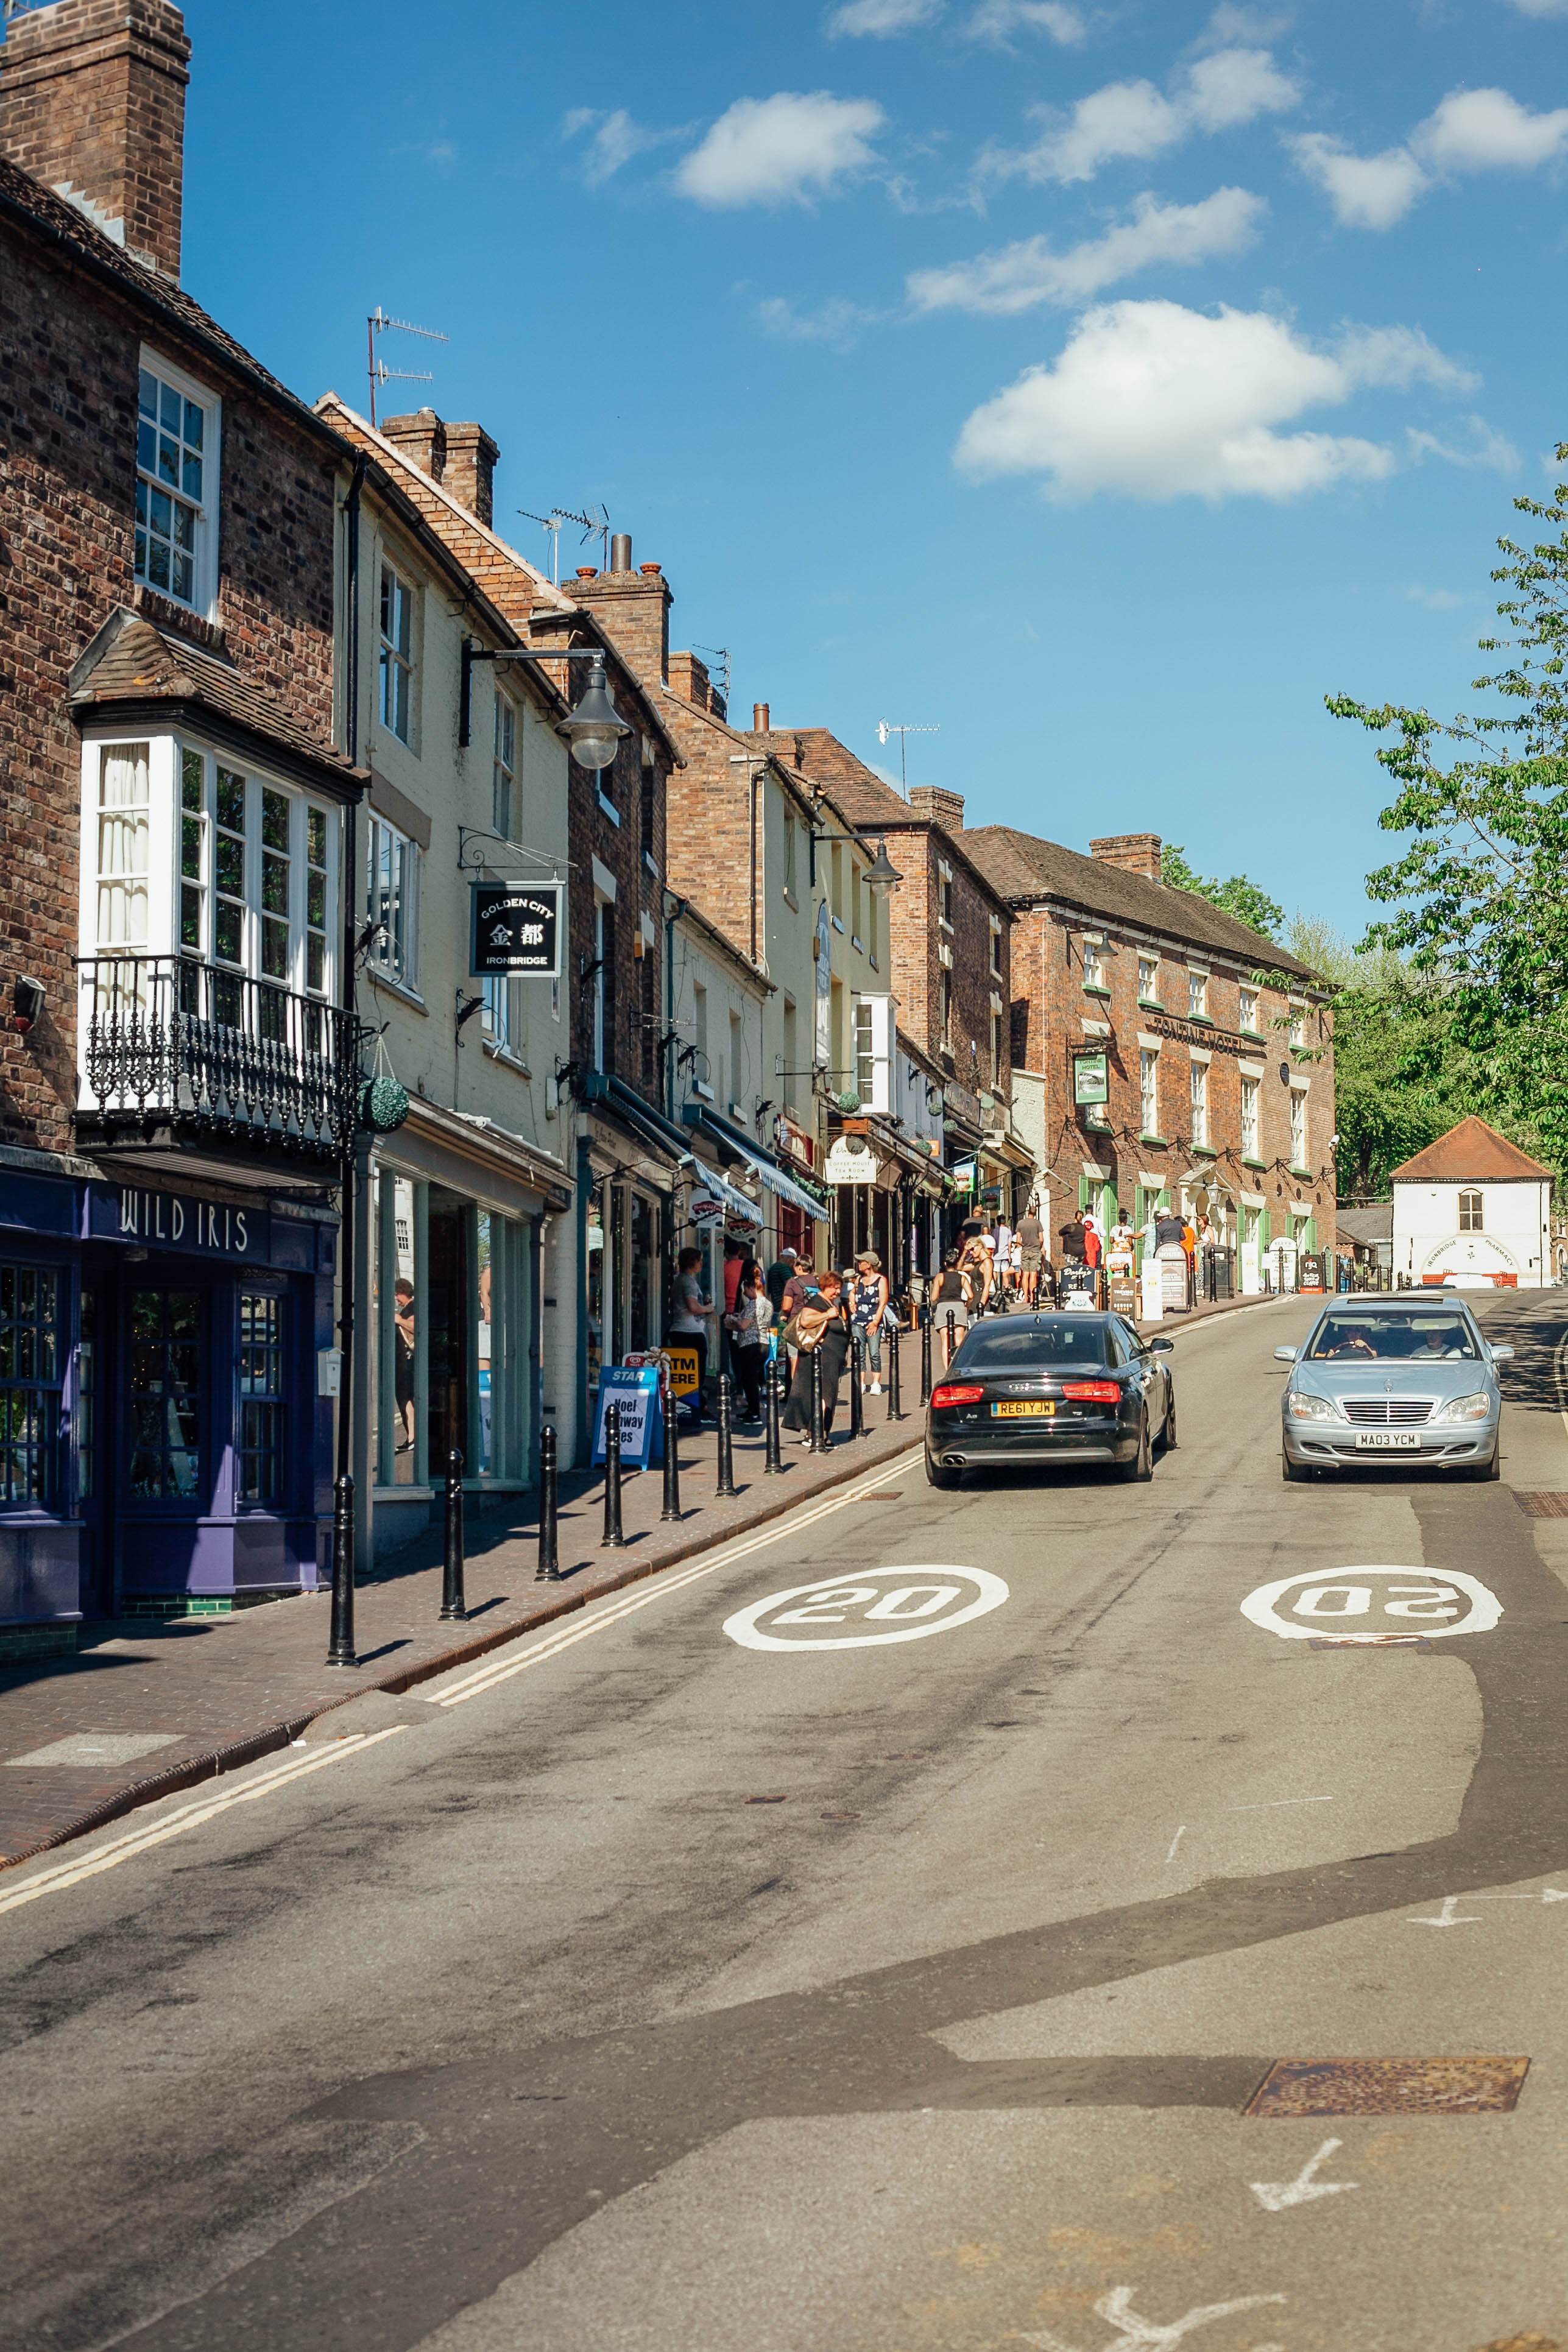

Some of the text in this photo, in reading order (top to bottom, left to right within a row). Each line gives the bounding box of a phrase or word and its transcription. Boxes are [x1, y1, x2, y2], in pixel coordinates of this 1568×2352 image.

[481, 899, 554, 919] GOLDEN CITY
[490, 924, 543, 945] 金都
[1154, 1017, 1246, 1059] TONTINE HOTEL
[121, 1189, 247, 1252] WILD IRIS
[1427, 1239, 1514, 1267] IRONBRIDGE PHARMACY
[612, 1371, 645, 1382] STAR
[670, 1373, 696, 1384] ERE
[1001, 1402, 1050, 1414] RE61 YJW
[1361, 1435, 1414, 1444] MA03 YCM
[771, 1586, 962, 1625] 20
